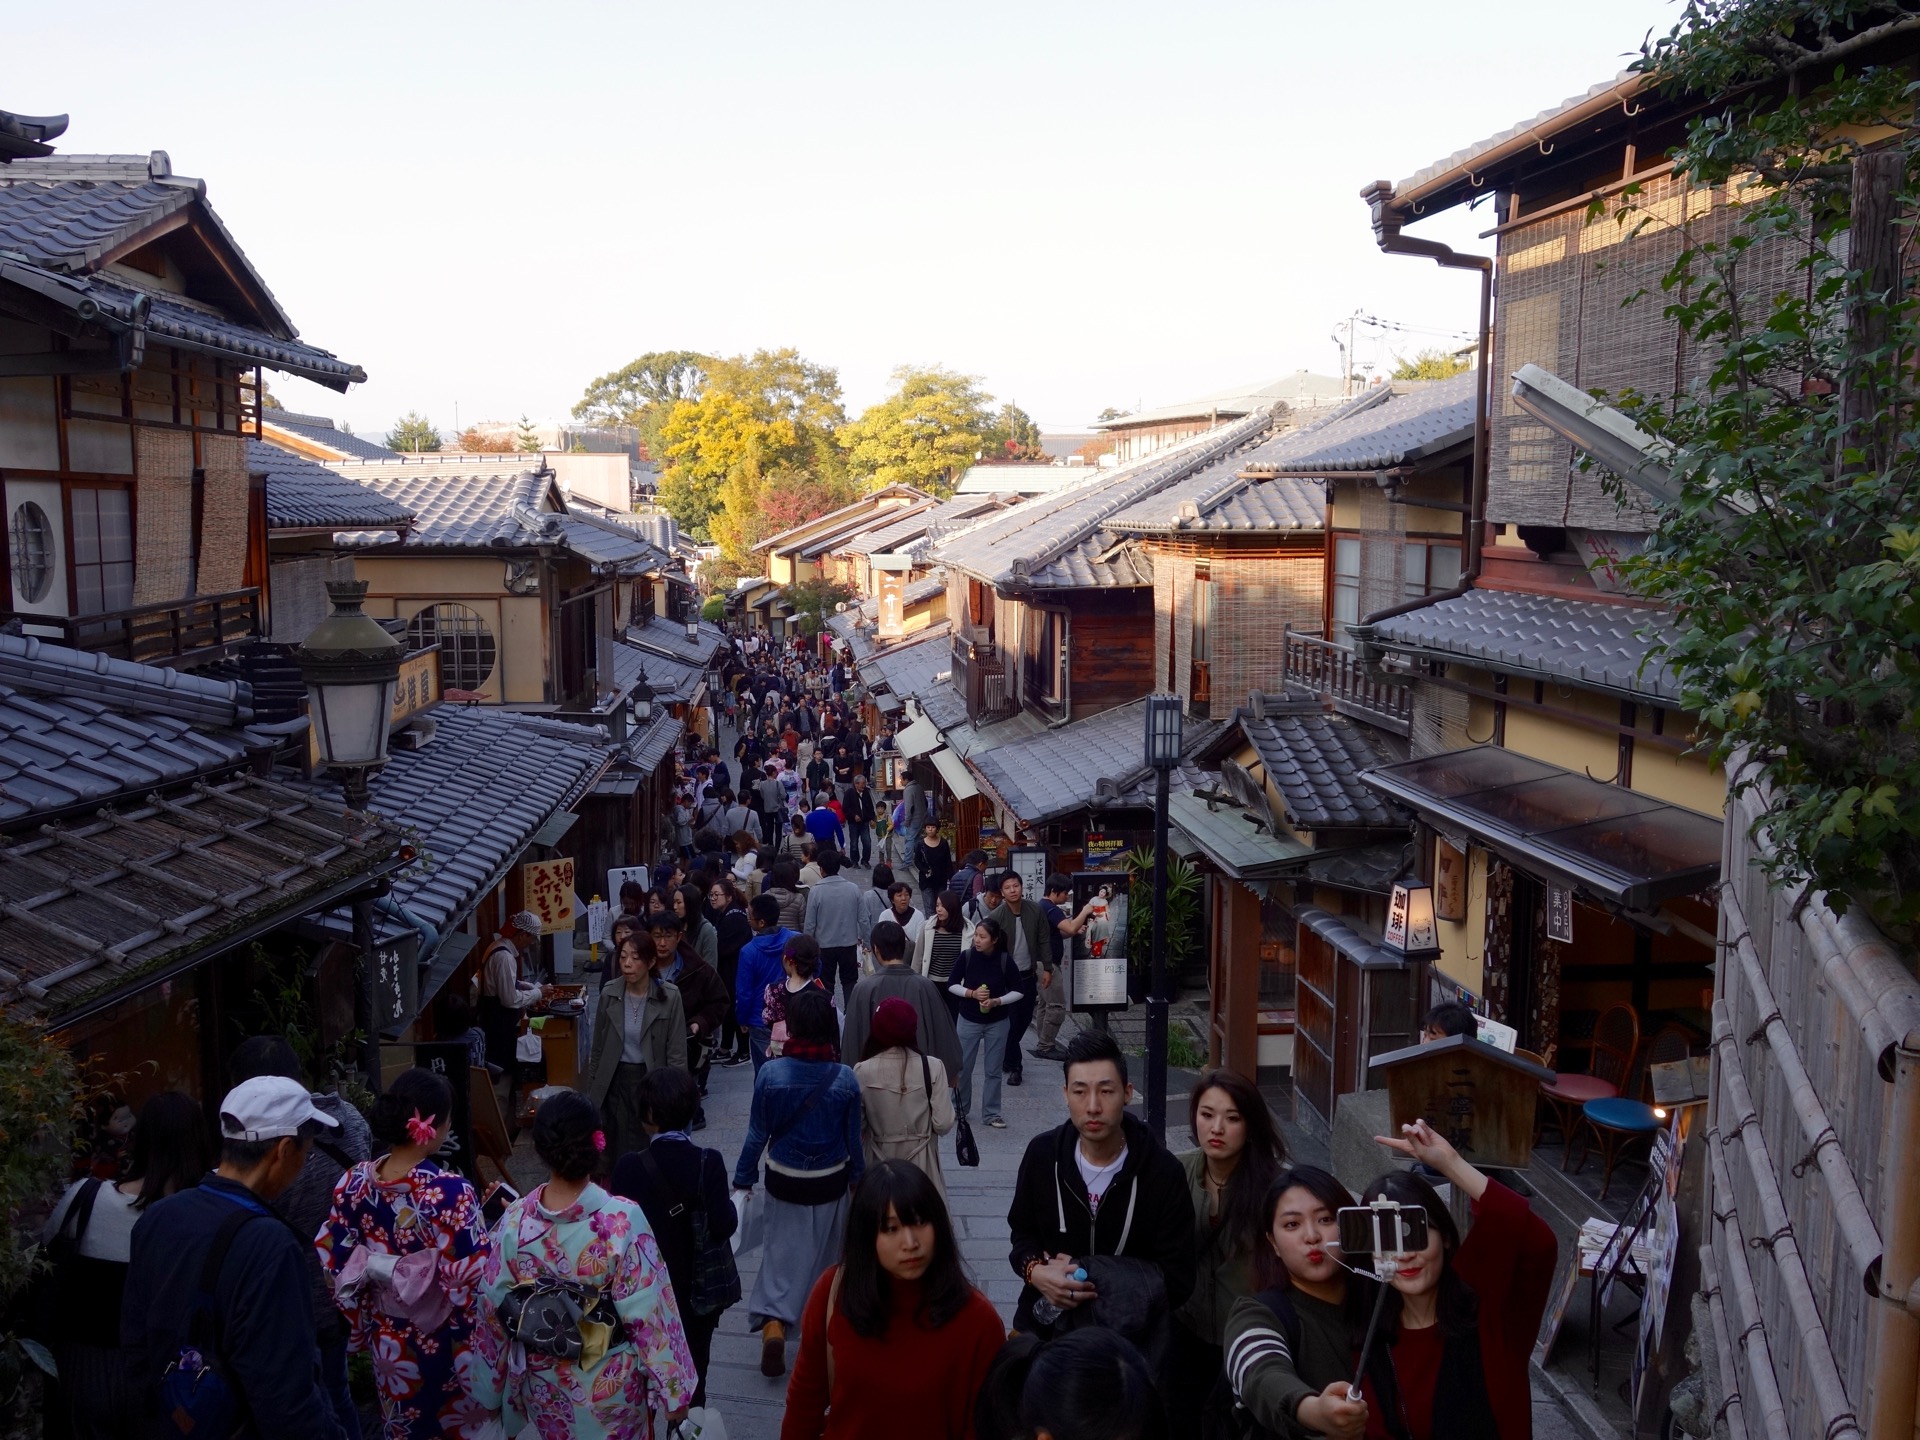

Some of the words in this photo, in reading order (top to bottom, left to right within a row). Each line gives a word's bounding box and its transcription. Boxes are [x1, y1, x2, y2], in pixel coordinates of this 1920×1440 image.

[553, 864, 564, 906] もっちり
[1035, 858, 1044, 885] そば処
[534, 868, 555, 924] あげもち
[1391, 890, 1406, 932] 珈琲
[1553, 888, 1562, 932] 業中
[1387, 930, 1404, 945] COFFEE
[1104, 965, 1126, 975] 四季
